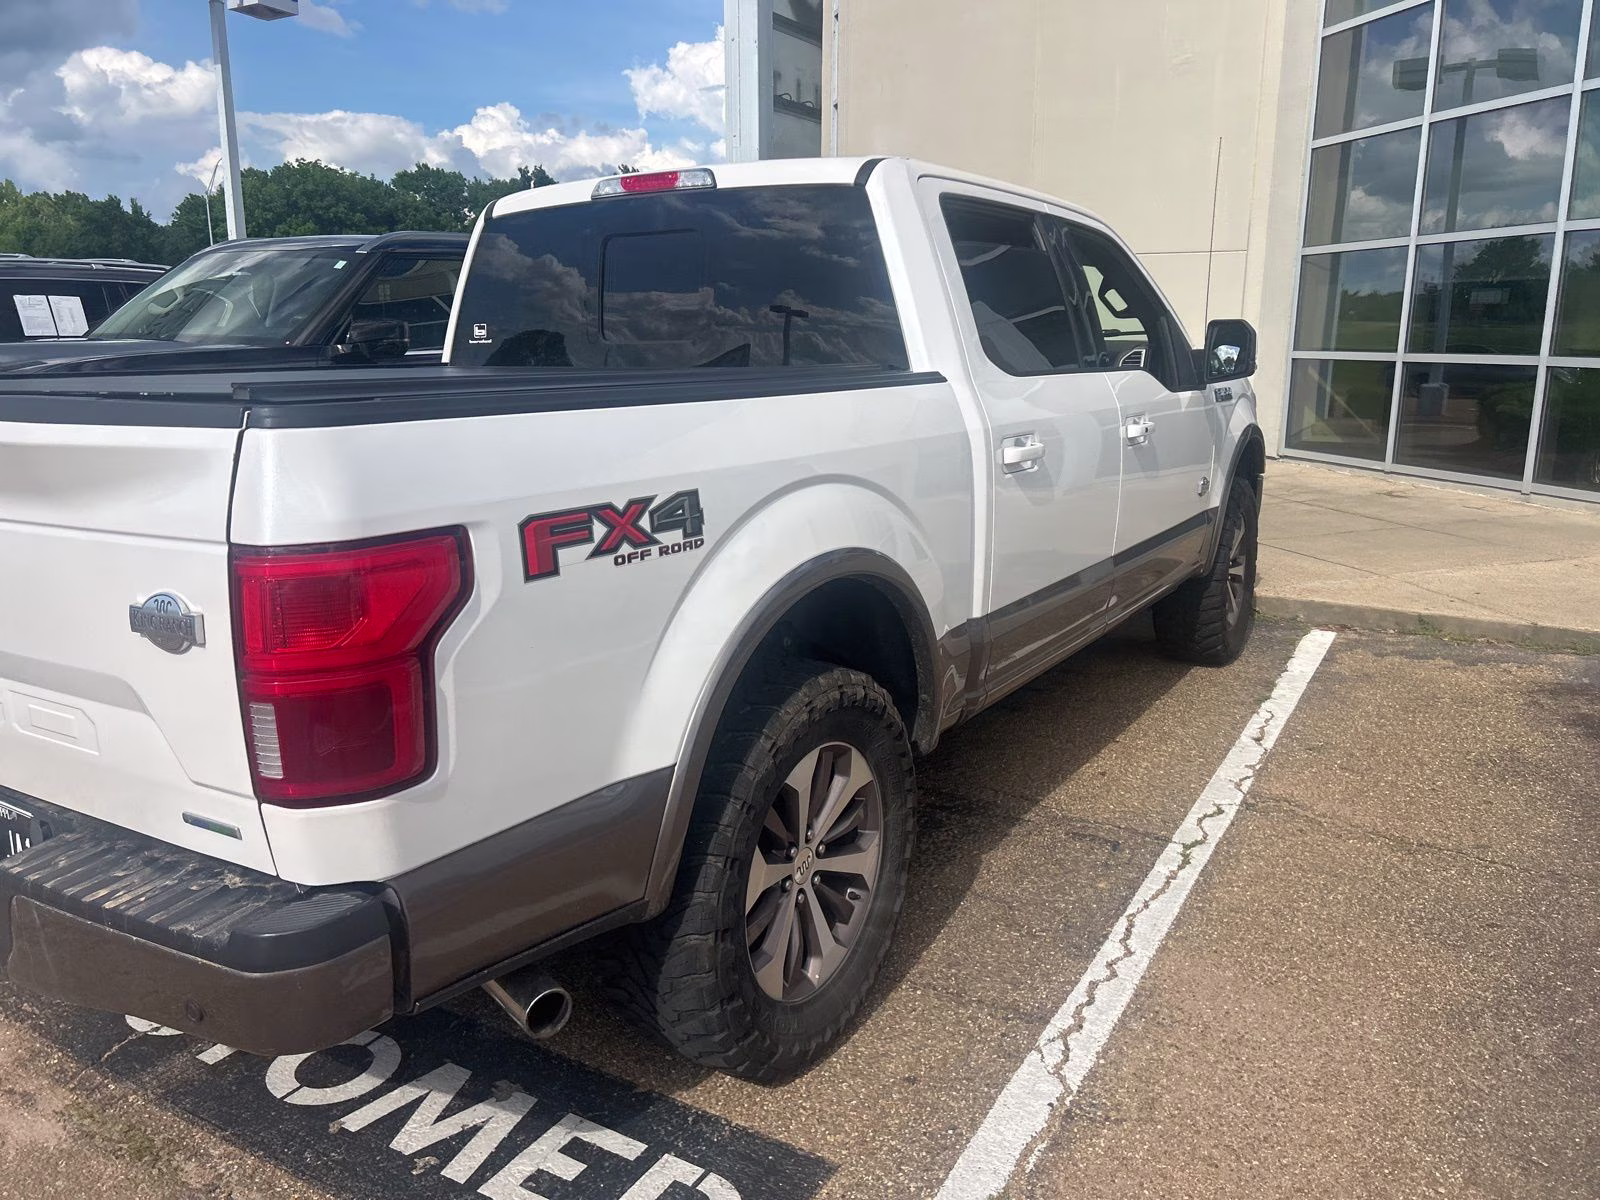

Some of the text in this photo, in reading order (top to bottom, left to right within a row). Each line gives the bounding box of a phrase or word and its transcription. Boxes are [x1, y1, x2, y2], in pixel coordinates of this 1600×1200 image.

[517, 488, 704, 584] FX4
[613, 538, 705, 567] OFF ROAD
